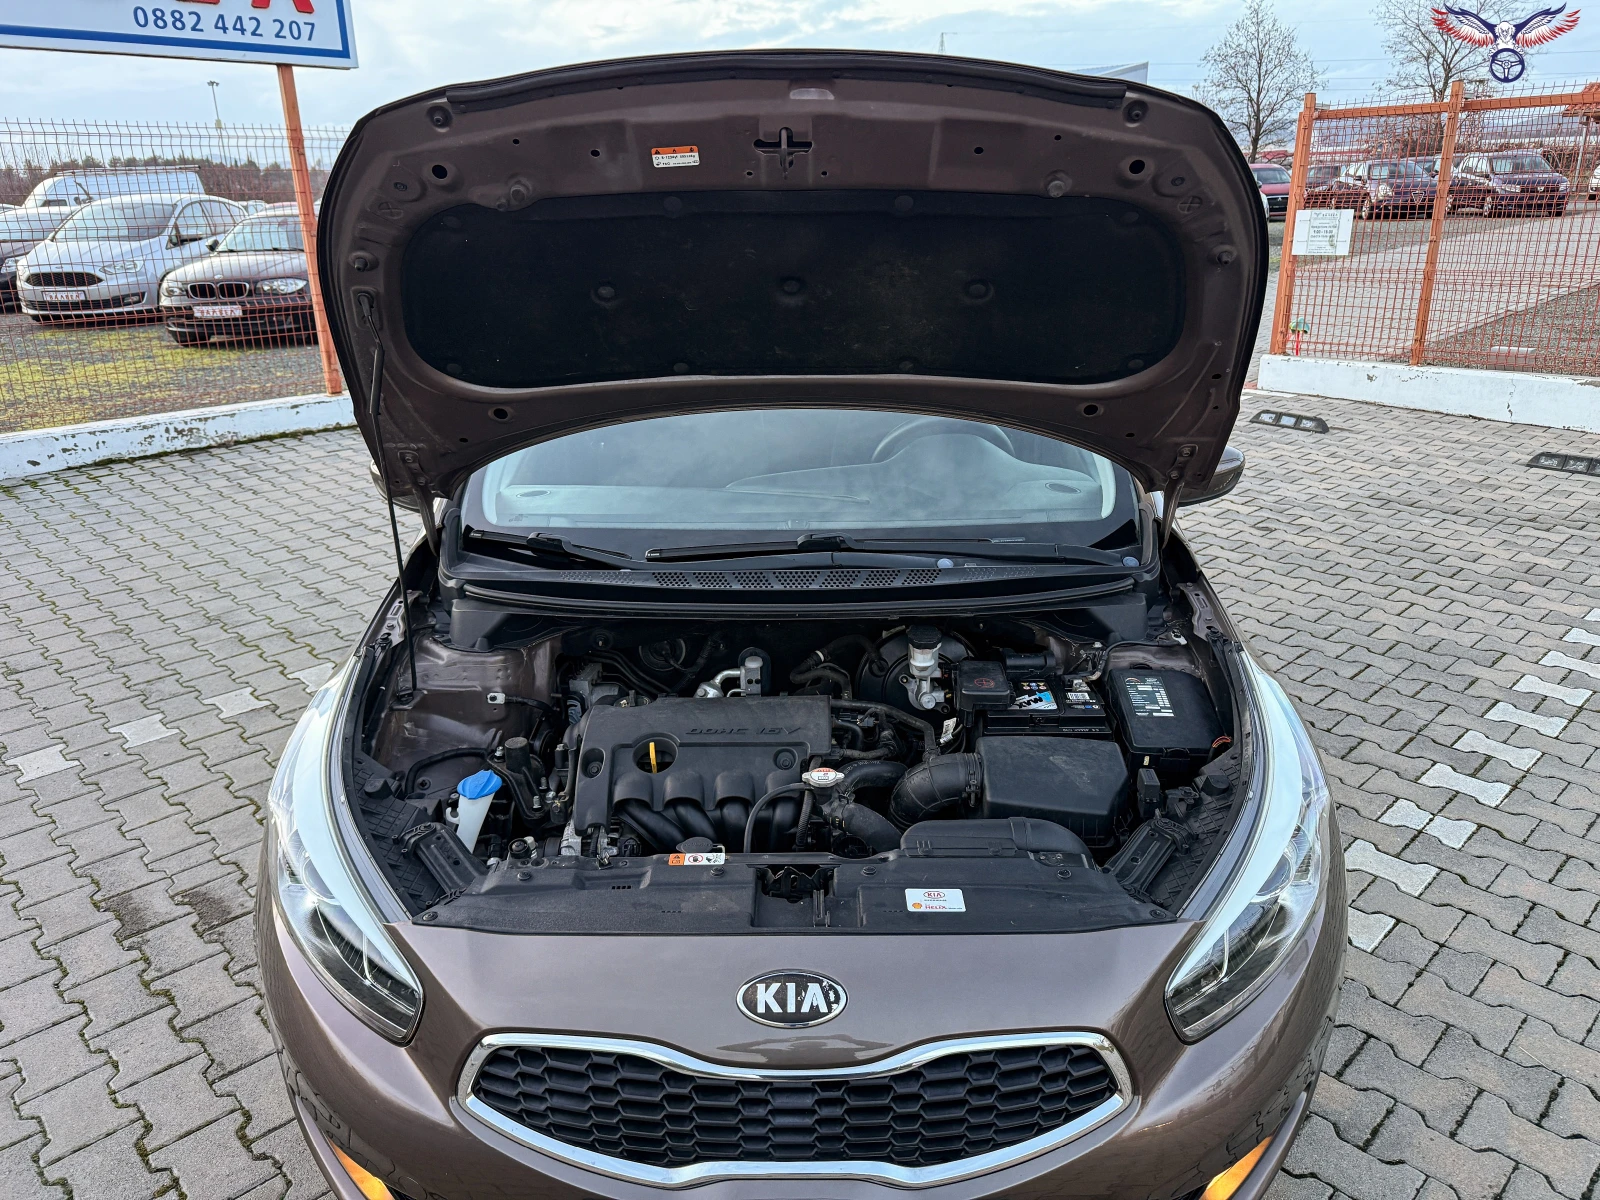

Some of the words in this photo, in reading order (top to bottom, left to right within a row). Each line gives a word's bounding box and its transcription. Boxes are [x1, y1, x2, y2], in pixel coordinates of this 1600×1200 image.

[133, 6, 204, 32] 0882
[213, 14, 264, 36] 442
[272, 18, 316, 41] 207
[685, 727, 749, 735] DOHC
[756, 727, 802, 735] 16V
[756, 982, 829, 1013] KIA
